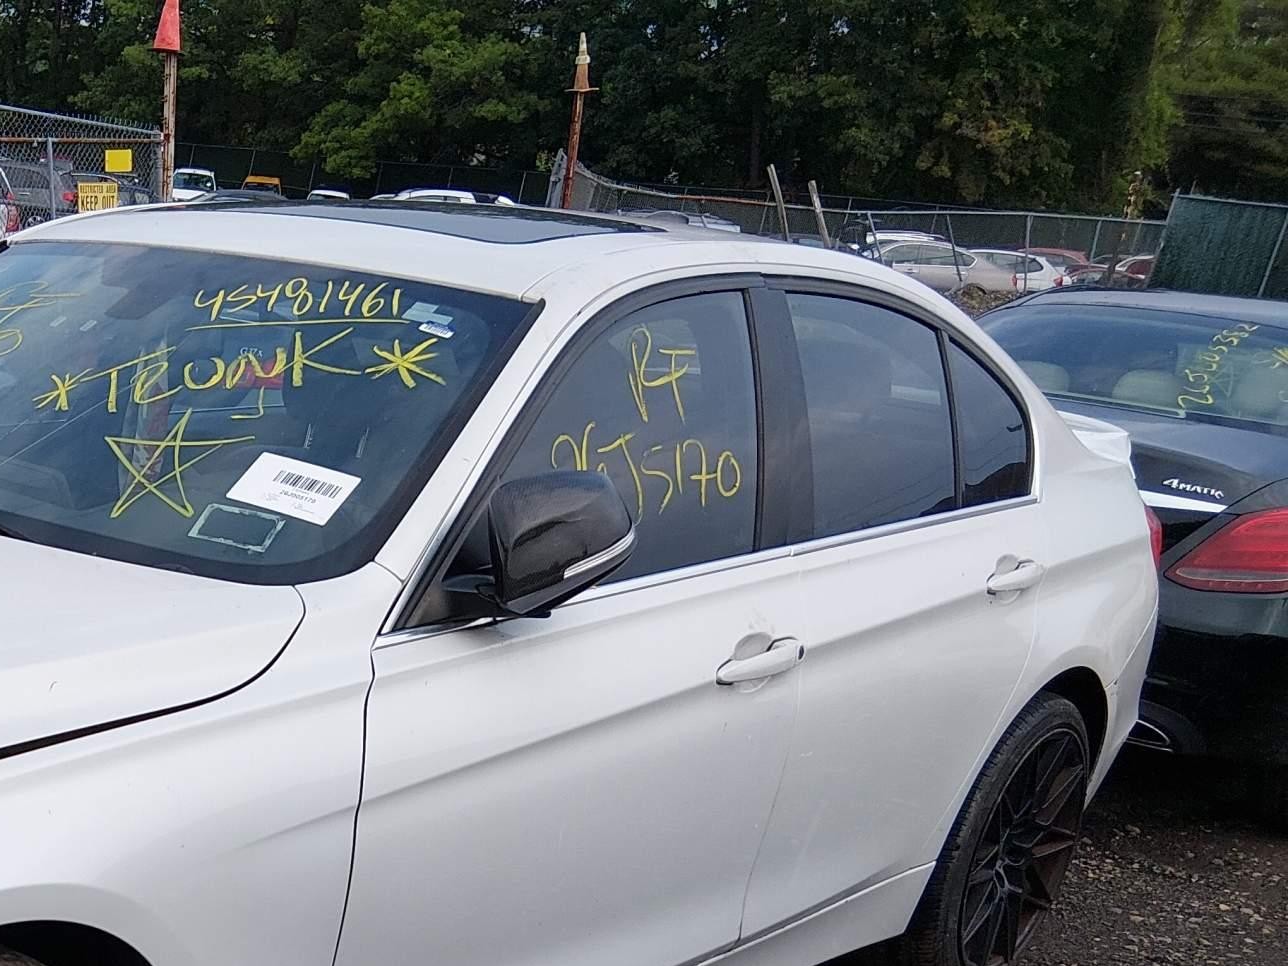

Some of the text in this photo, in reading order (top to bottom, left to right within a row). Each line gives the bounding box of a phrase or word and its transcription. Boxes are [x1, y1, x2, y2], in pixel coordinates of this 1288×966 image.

[80, 195, 115, 211] KEEP OUT
[194, 277, 401, 322] 45481461
[1162, 477, 1225, 501] 4MATIC
